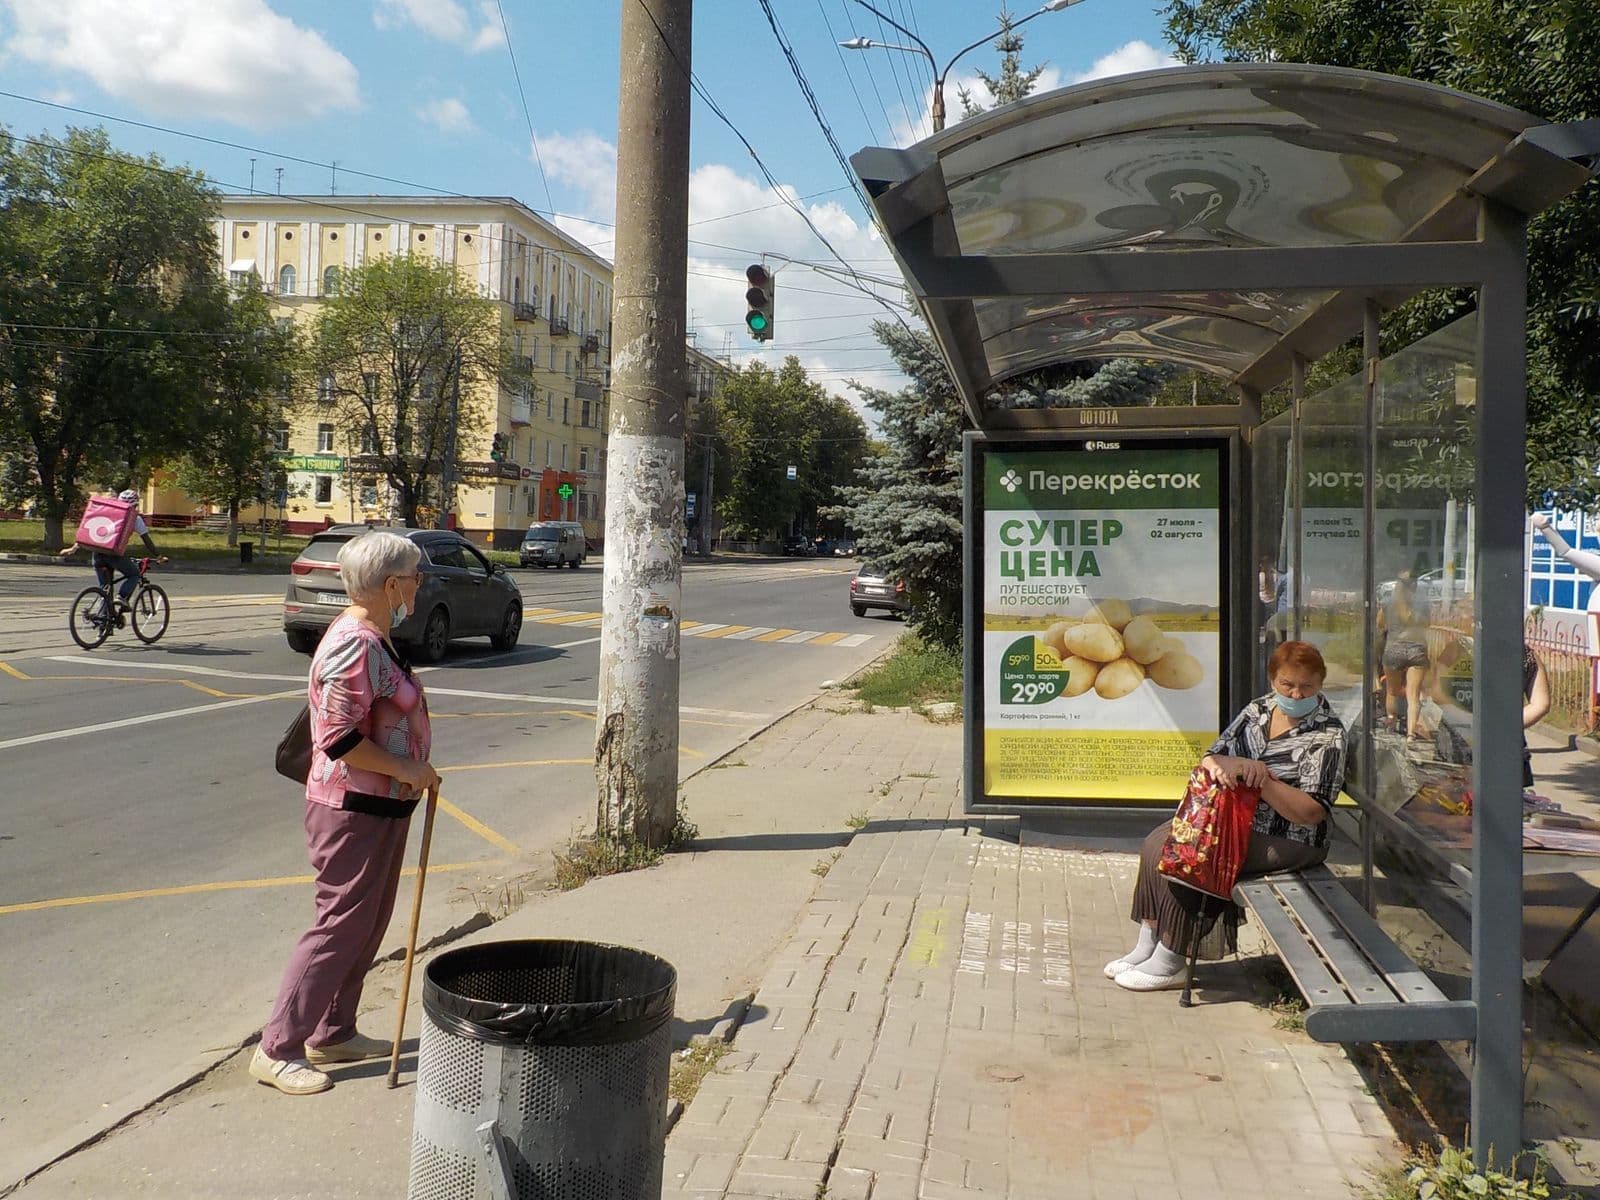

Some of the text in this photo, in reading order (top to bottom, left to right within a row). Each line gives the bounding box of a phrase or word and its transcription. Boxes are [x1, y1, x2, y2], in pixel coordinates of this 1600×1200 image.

[1096, 440, 1121, 450] Russ
[1029, 469, 1201, 495] Перекрёсток
[1156, 518, 1168, 526] 27
[999, 519, 1123, 547] СУПЕР
[1150, 530, 1203, 540] 02 августа
[1000, 550, 1102, 582] ЦЕНА
[1000, 584, 1088, 595] ПУТЕШЕСТВУЕТ
[1000, 596, 1070, 606] ПО РОССИИ
[1004, 672, 1025, 680] Цена
[1038, 673, 1060, 681] карте
